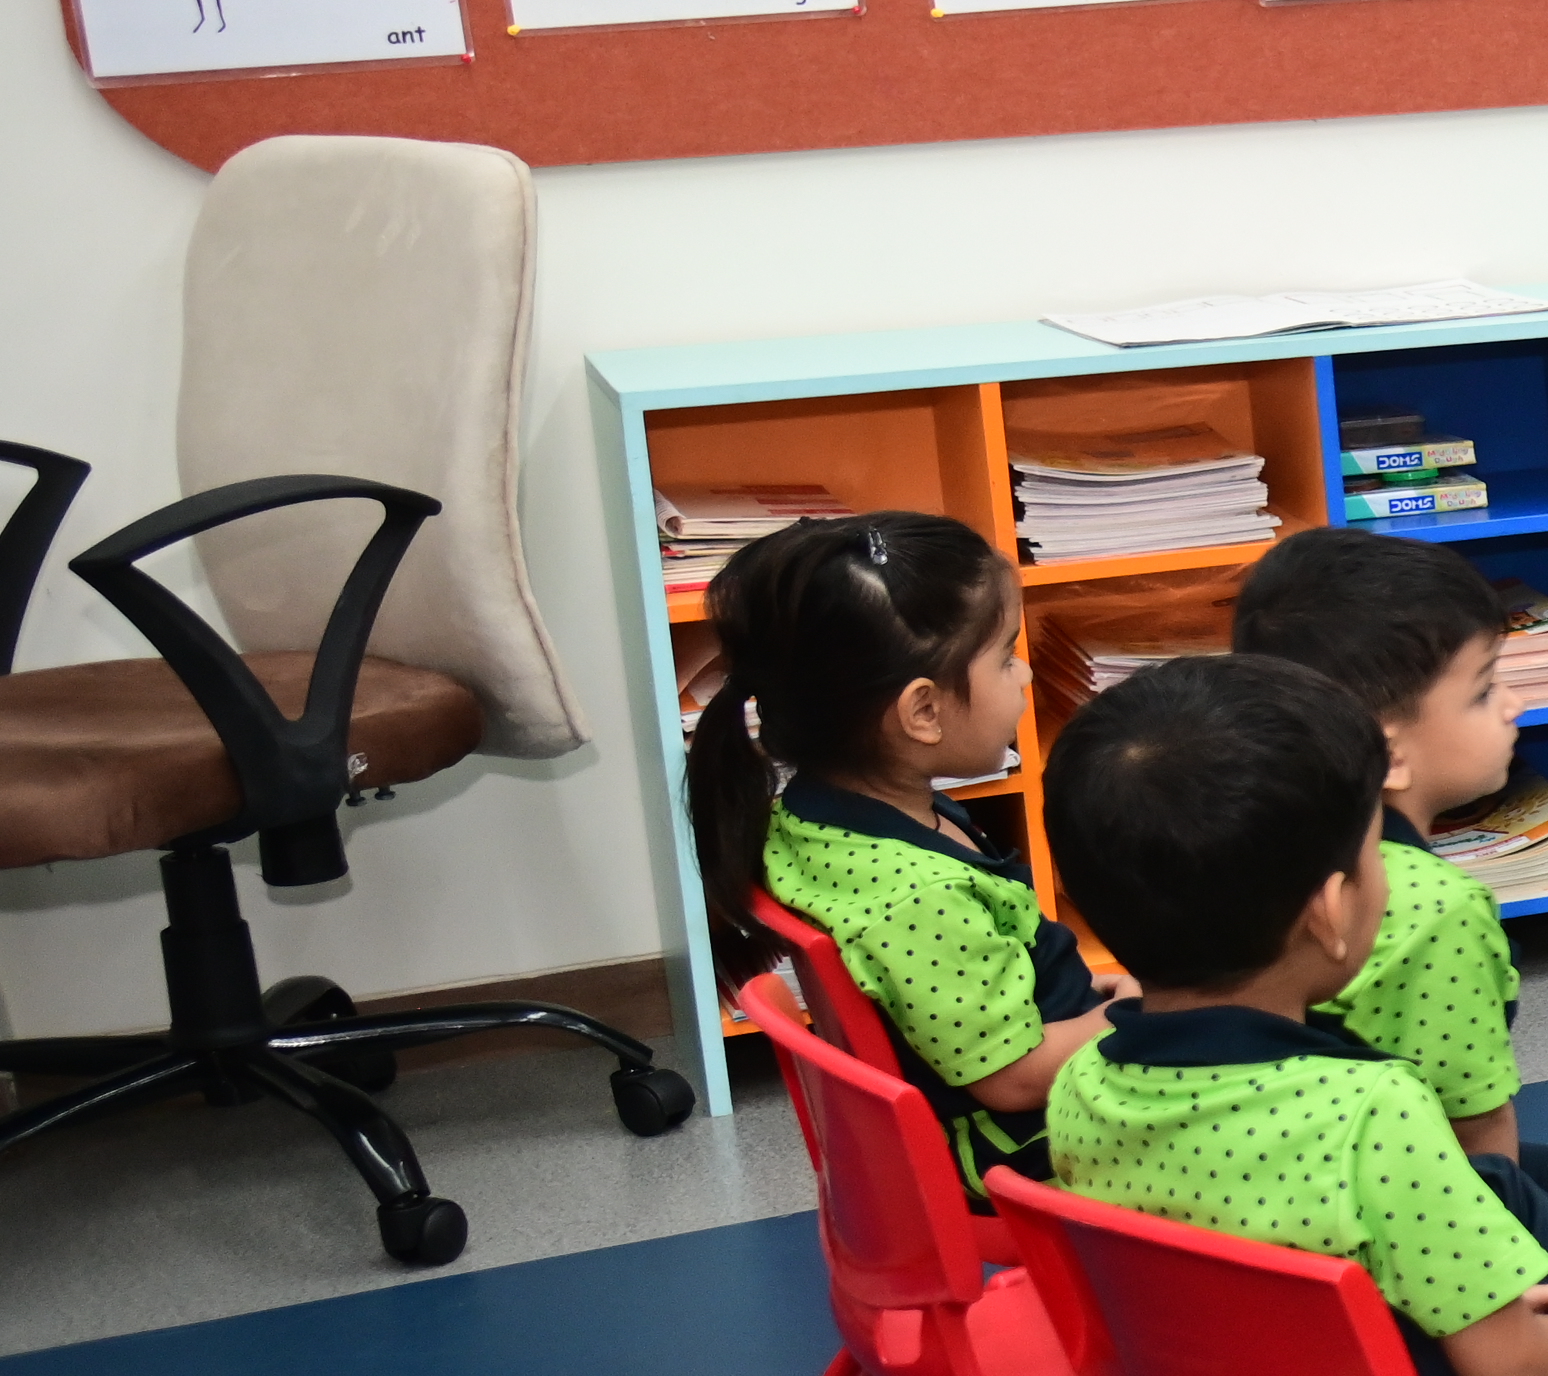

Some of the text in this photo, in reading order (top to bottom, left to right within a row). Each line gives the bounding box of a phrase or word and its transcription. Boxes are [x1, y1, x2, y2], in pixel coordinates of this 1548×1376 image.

[387, 25, 427, 45] ant
[1378, 454, 1421, 468] DOMS
[1391, 497, 1433, 512] DOMS
